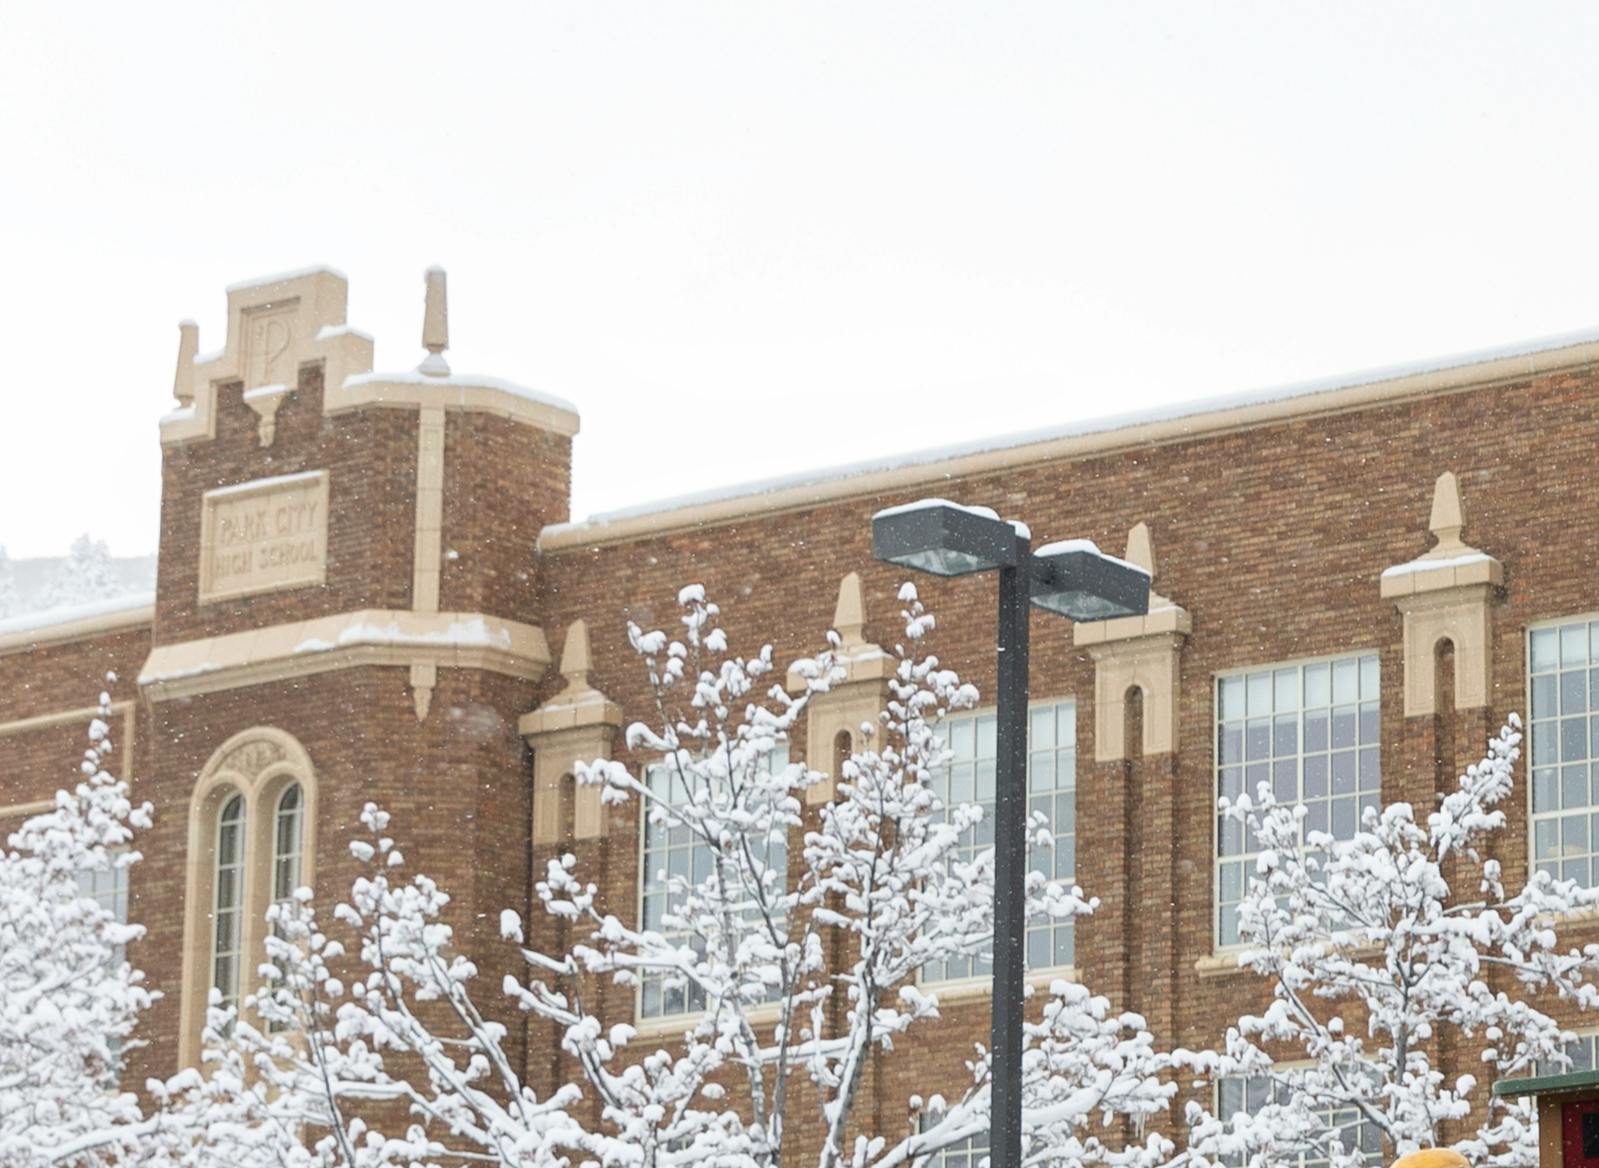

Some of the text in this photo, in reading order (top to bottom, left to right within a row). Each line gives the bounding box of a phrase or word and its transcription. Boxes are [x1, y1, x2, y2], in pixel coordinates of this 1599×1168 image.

[220, 501, 318, 546] PARK CITY
[215, 540, 318, 579] HIGH SCHOOL
